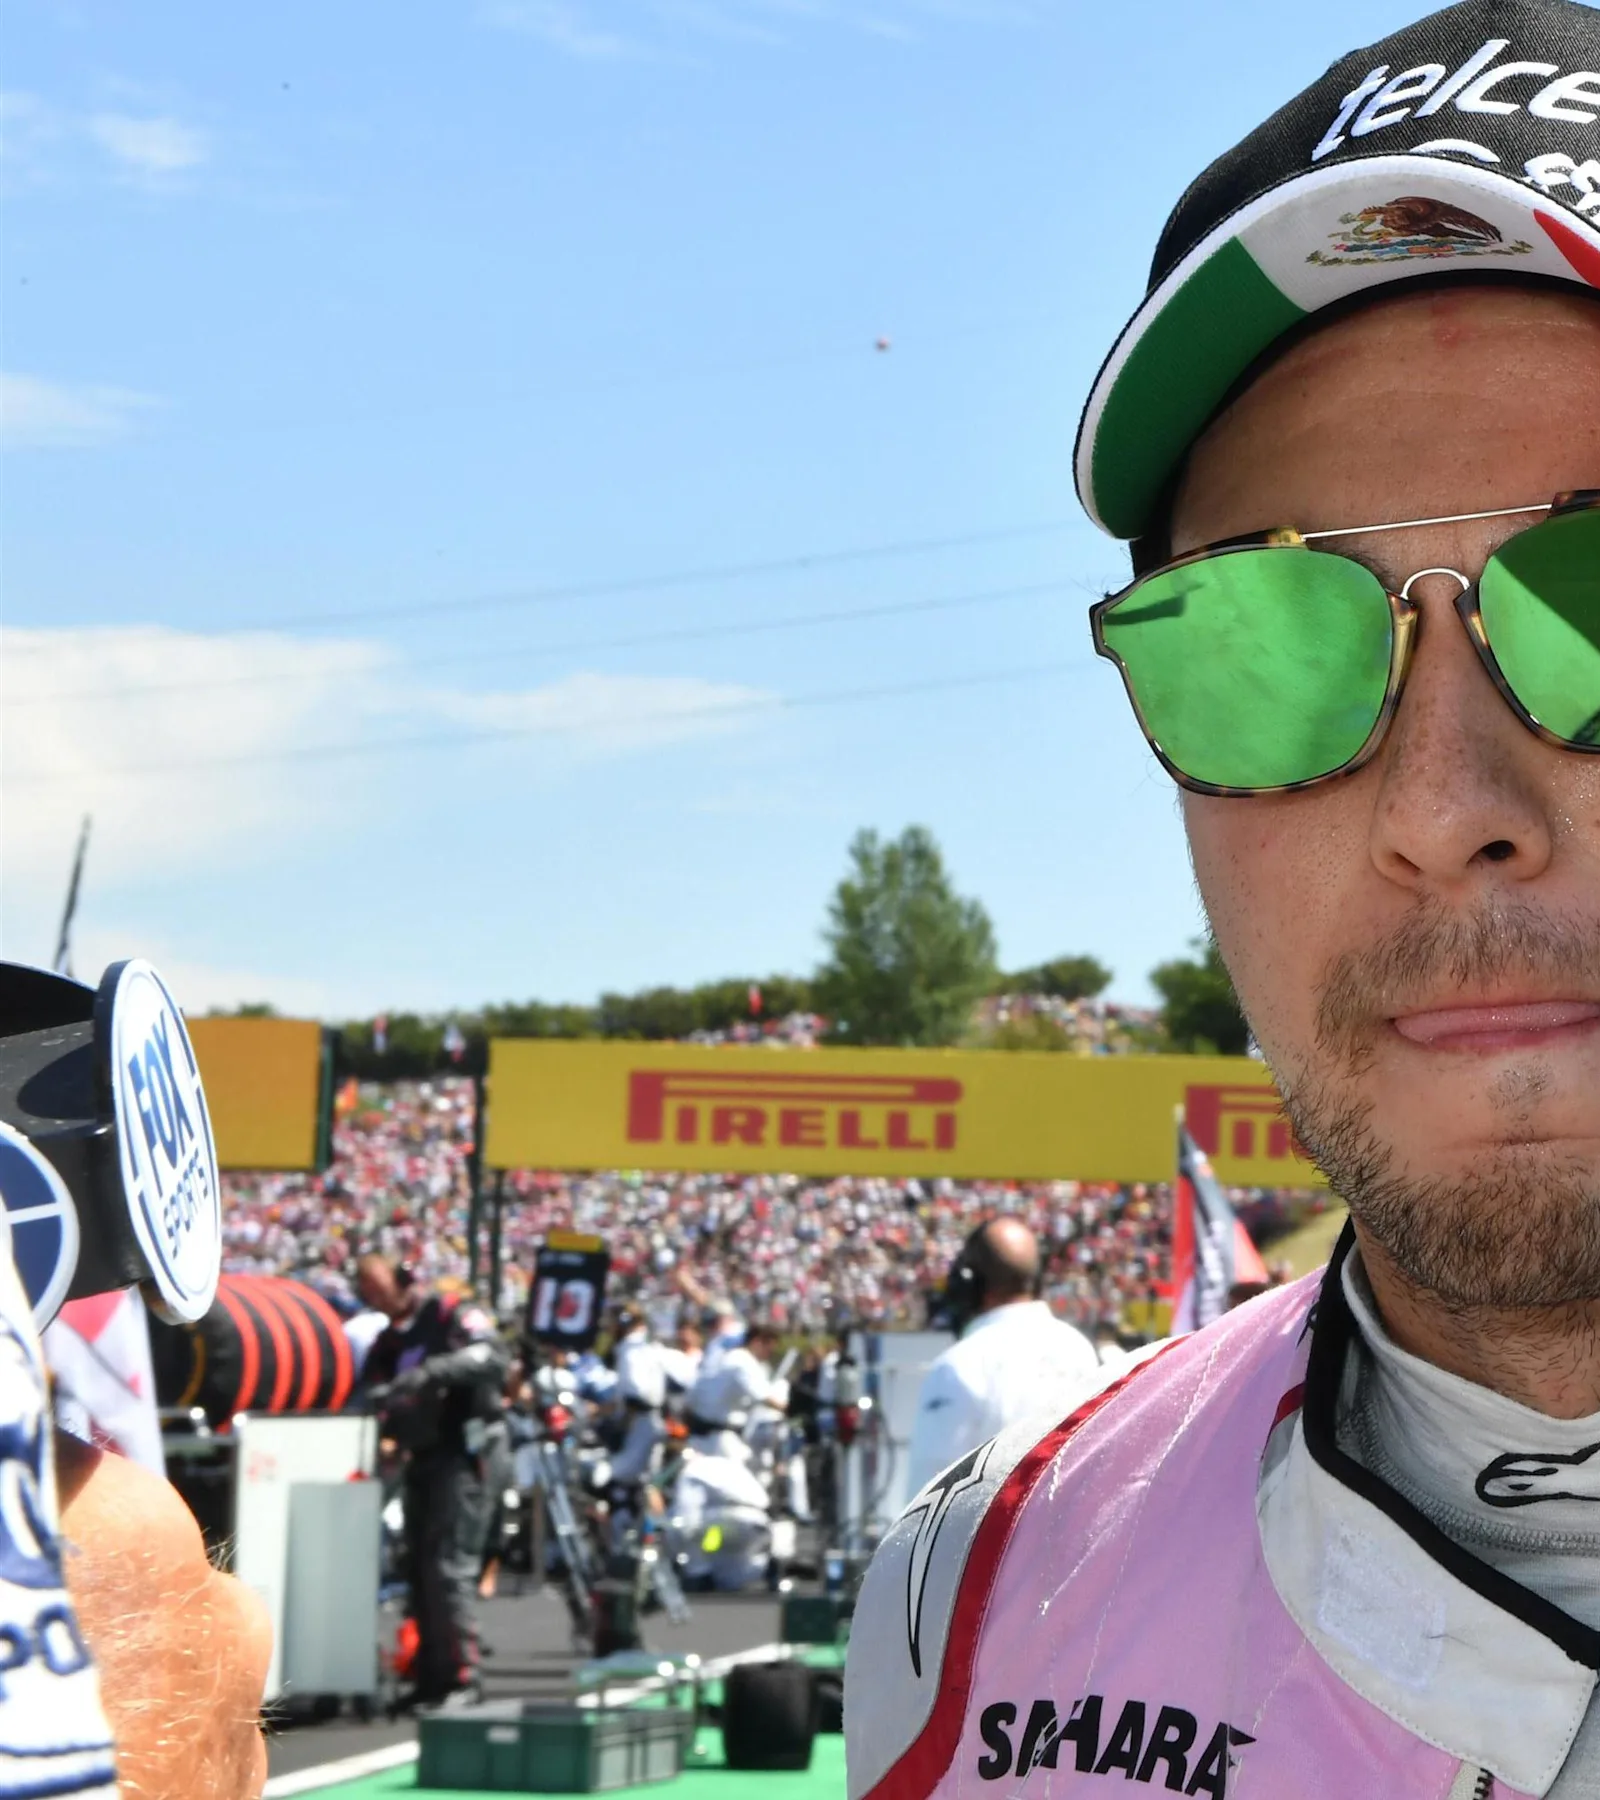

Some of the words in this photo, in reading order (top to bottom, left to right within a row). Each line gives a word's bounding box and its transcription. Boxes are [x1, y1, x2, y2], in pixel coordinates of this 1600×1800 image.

[127, 1008, 195, 1198] FOX
[626, 1070, 964, 1150] PIRELLI
[164, 1147, 208, 1261] SPORTS
